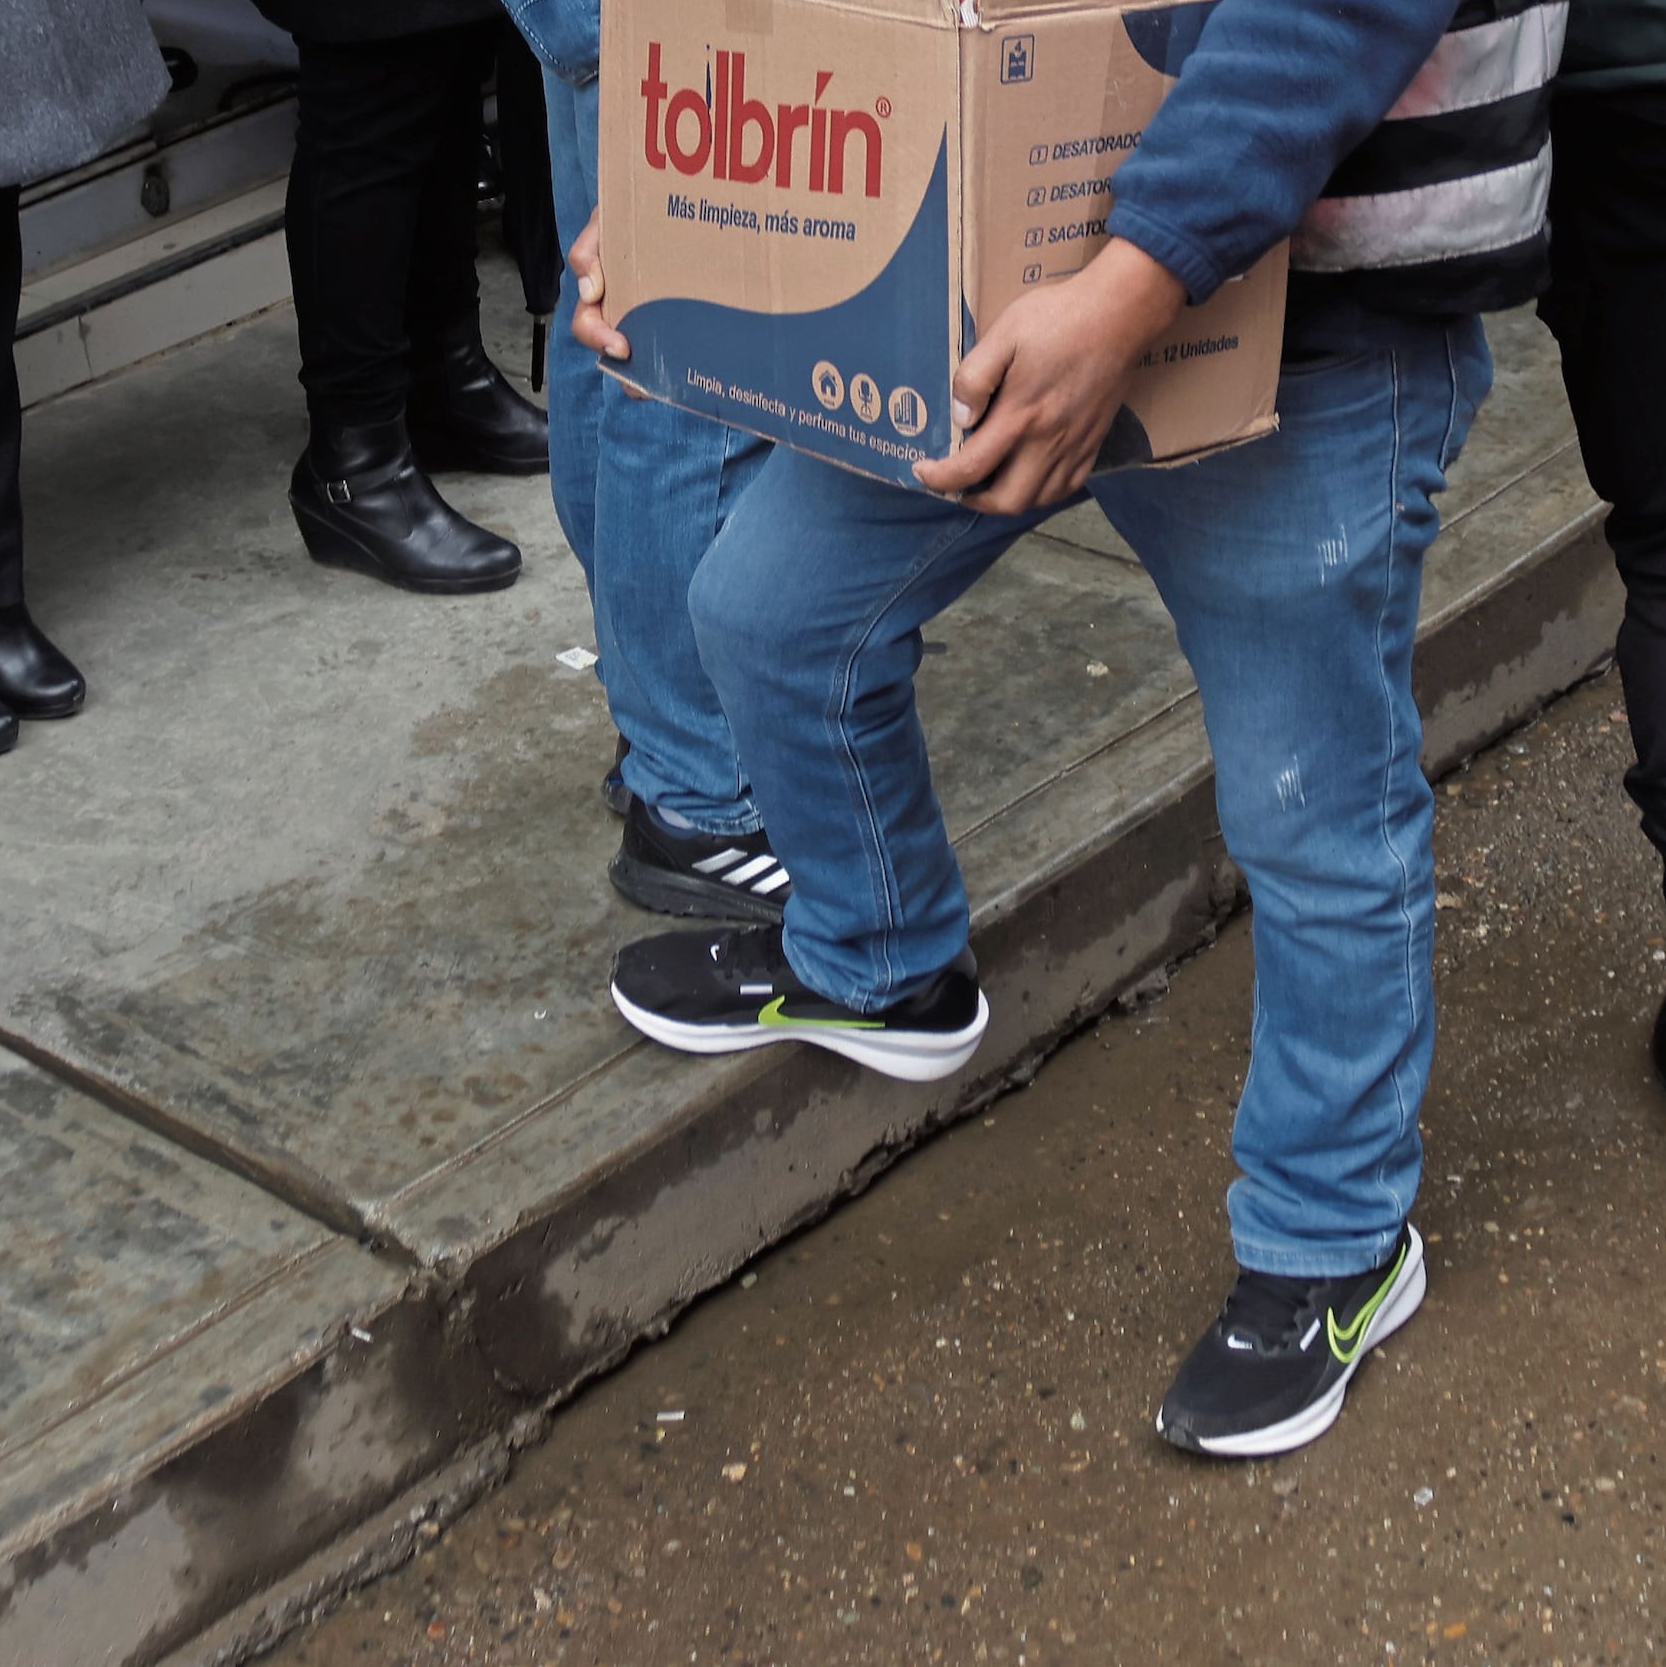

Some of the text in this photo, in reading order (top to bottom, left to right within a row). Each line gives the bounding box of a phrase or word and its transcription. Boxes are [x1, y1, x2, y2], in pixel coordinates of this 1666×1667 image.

[668, 193, 856, 241] Más limpieza, más aroma
[1164, 344, 1178, 363] 12
[1181, 335, 1239, 360] Unidades
[687, 367, 926, 462] Limpia, desinfecta y perfuma tus espacios
